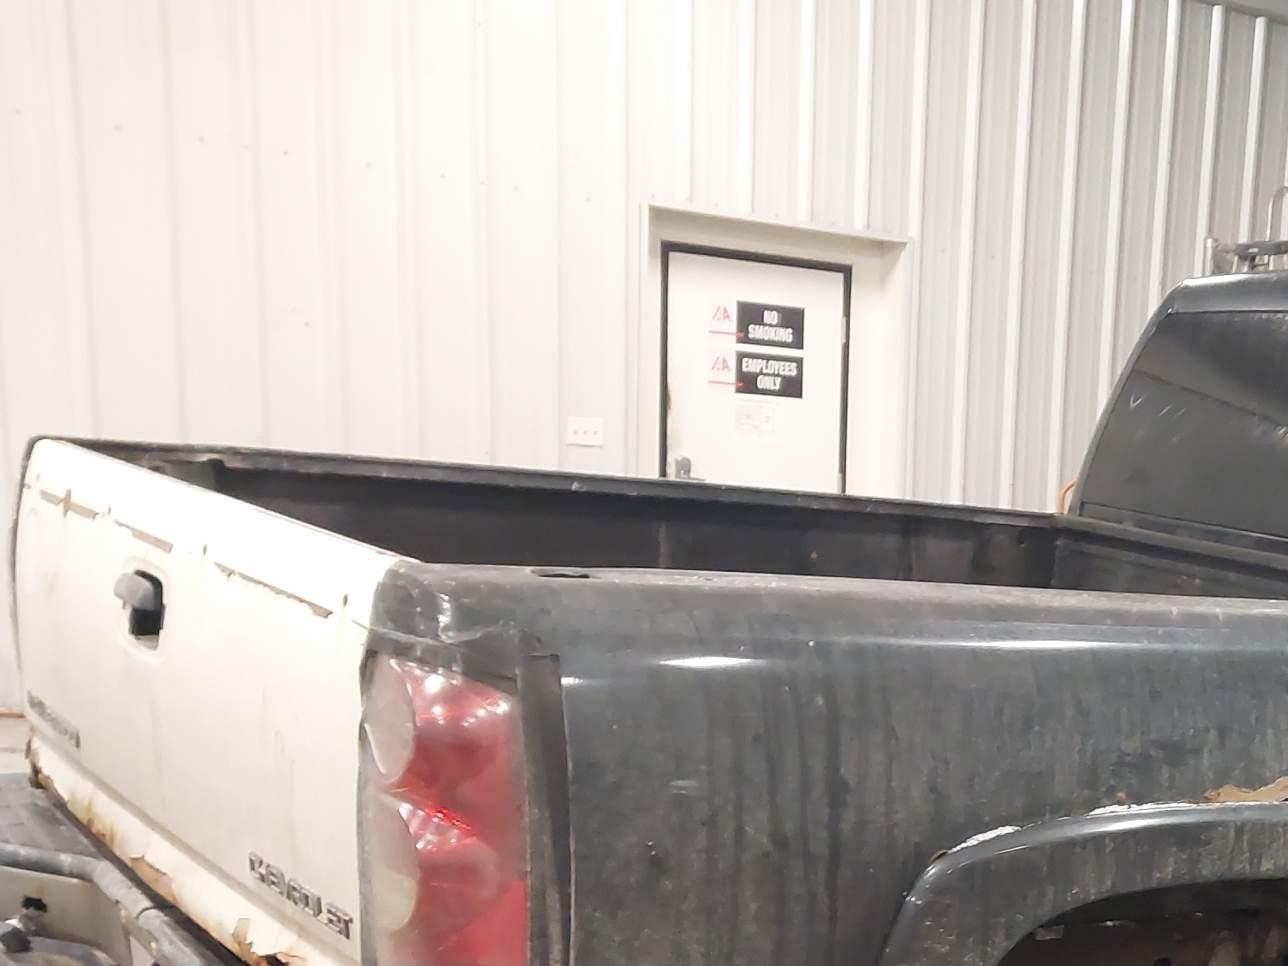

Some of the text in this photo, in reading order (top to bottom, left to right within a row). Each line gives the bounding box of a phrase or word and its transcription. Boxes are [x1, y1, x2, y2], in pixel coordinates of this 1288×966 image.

[763, 310, 778, 325] NO
[748, 324, 793, 342] SMOKING
[742, 358, 797, 376] EMPLOYEES
[756, 375, 781, 390] ONLY
